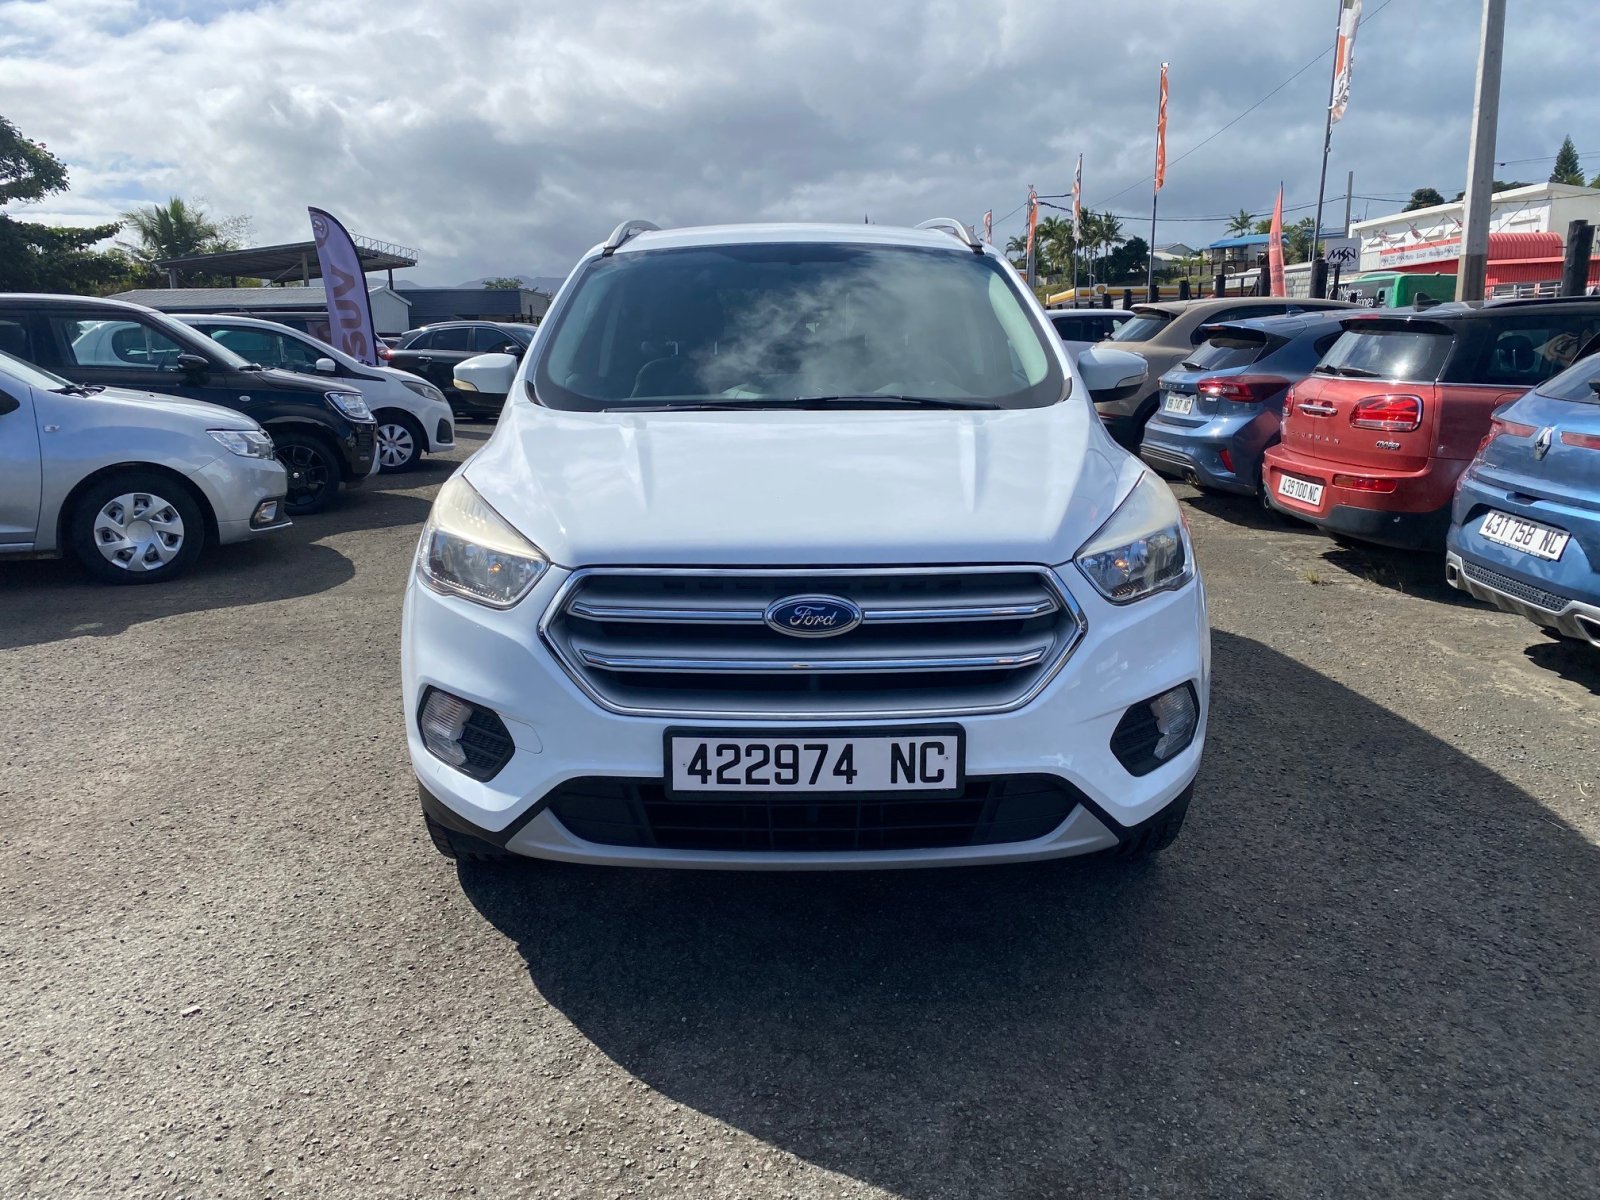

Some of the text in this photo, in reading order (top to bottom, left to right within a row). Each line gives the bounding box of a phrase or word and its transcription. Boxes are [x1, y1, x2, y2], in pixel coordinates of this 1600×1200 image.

[330, 263, 368, 358] SUV
[1307, 484, 1319, 502] NC
[1539, 529, 1564, 554] NC
[789, 605, 838, 626] Ford
[687, 741, 945, 786] 422974 NC
